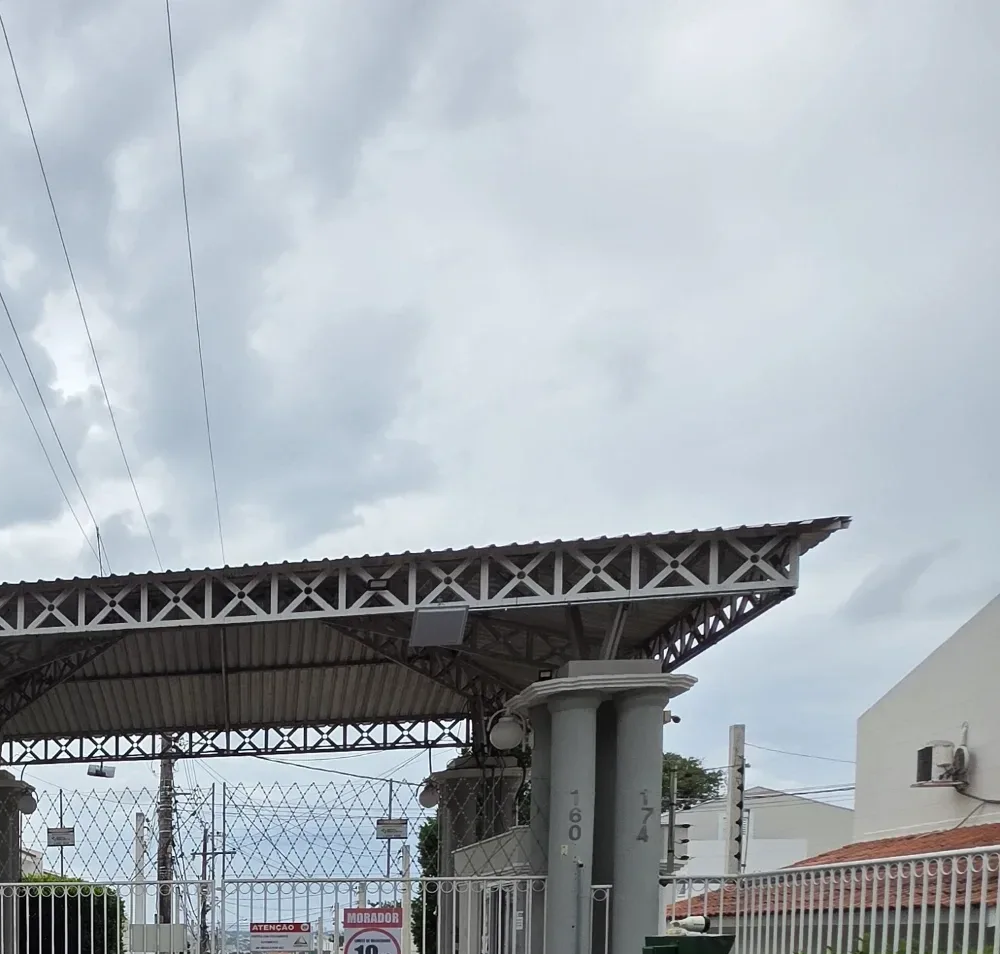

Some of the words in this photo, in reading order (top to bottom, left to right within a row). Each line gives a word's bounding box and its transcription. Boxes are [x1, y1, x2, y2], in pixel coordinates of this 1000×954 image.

[568, 789, 582, 841] 160
[636, 789, 655, 842] 174
[252, 923, 295, 932] ATENÇÃO
[346, 912, 399, 924] MORADOR
